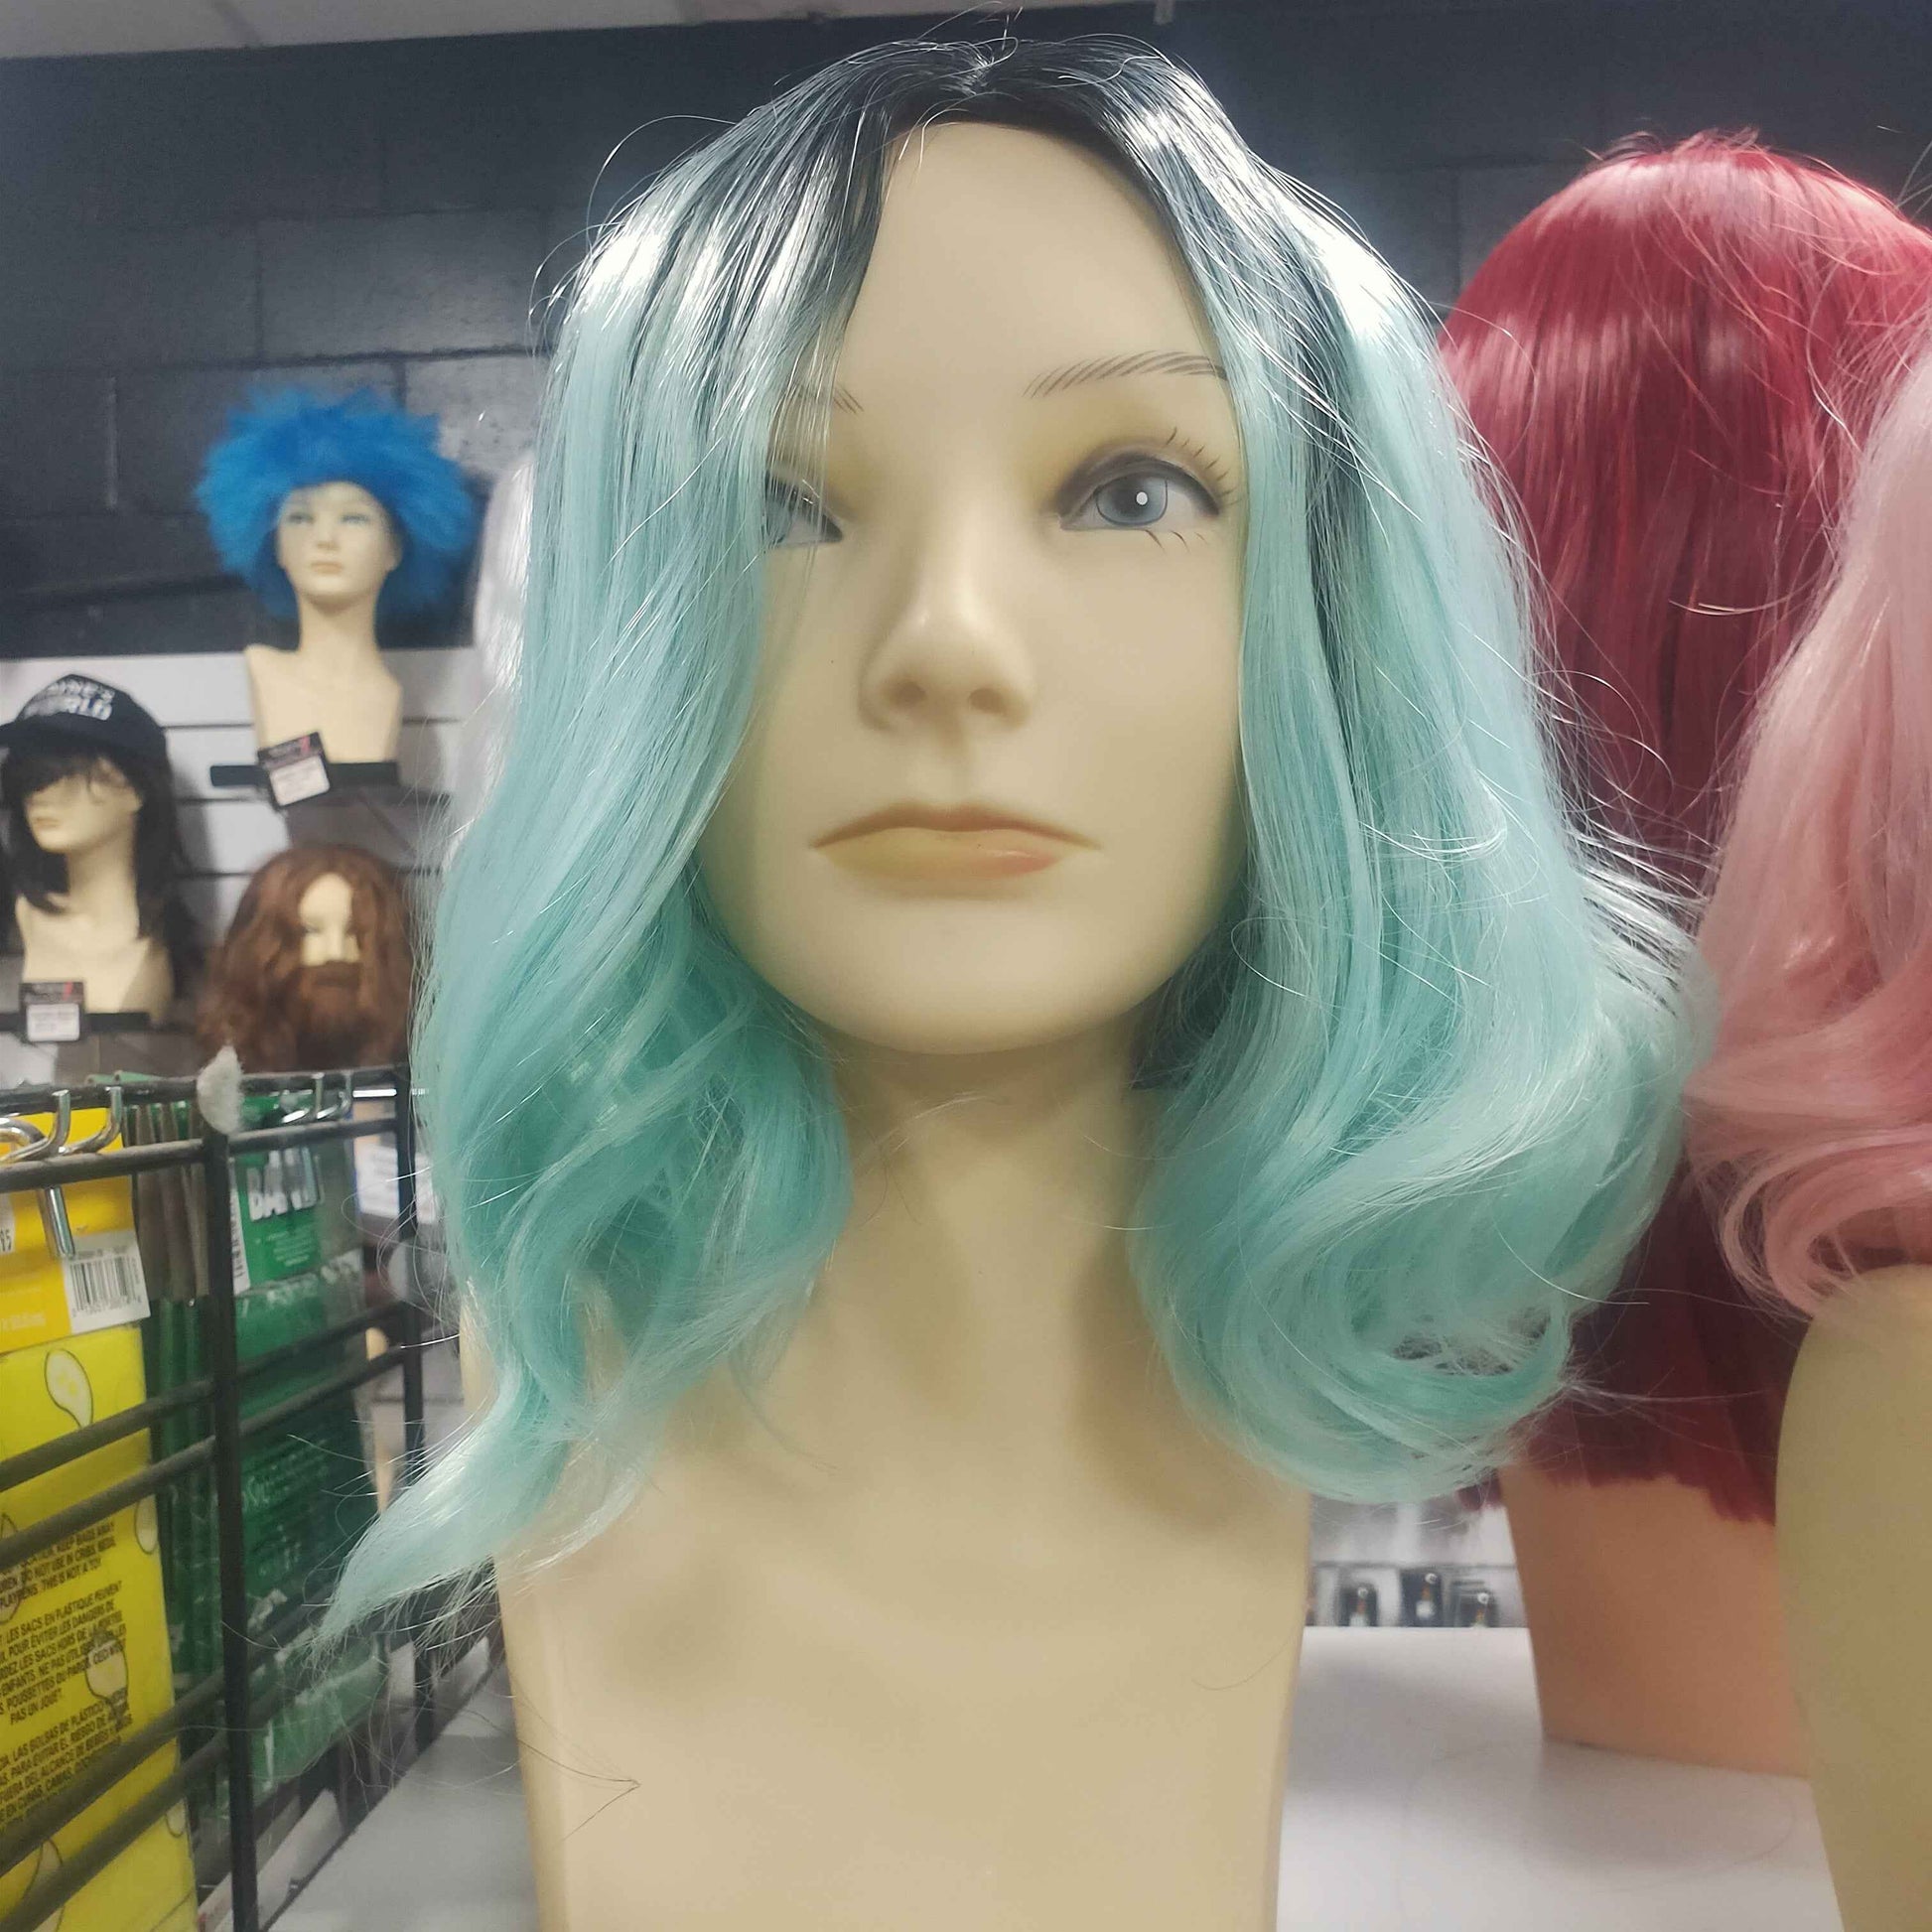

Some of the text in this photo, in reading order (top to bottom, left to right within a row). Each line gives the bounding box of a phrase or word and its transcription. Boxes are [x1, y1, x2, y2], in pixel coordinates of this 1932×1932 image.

[6, 1626, 20, 1643] LES
[20, 1616, 43, 1636] SACS
[44, 1611, 55, 1626] EN
[56, 1593, 93, 1620] PLASTIQUE
[8, 1638, 30, 1657] POUR
[19, 1653, 34, 1669] LES
[35, 1642, 58, 1662] SACS
[39, 1661, 51, 1676] NE
[11, 1708, 27, 1725] PAS
[28, 1701, 39, 1716] UN
[13, 1742, 29, 1762] LAS
